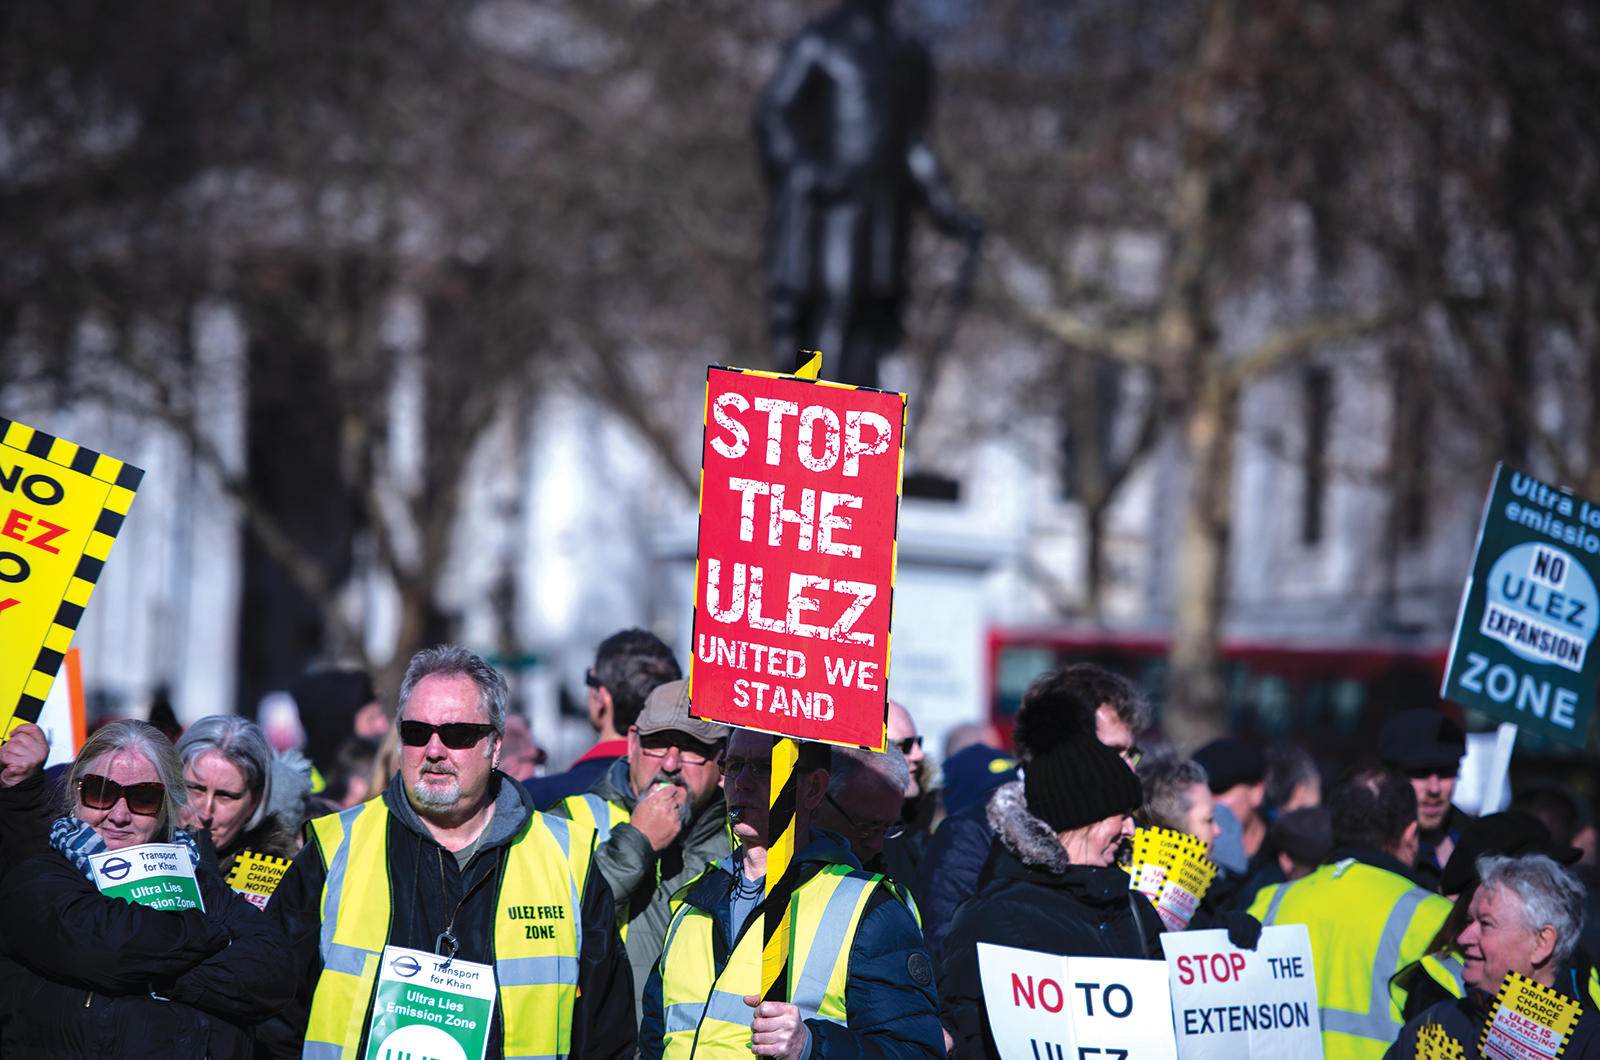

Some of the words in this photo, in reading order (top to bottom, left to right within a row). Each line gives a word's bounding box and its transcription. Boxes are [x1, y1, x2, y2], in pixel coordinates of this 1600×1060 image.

[710, 392, 892, 477] STOP
[1510, 471, 1574, 518] Ultra
[1579, 501, 1600, 529] lo
[0, 508, 70, 555] EZ
[729, 477, 863, 559] THE
[1504, 501, 1600, 558] emissio
[1533, 550, 1566, 584] NO
[706, 558, 877, 647] ULEZ
[1502, 573, 1588, 628] ULEZ
[1487, 609, 1583, 665] EXPANSION
[699, 634, 806, 679] UNITED
[824, 656, 879, 691] WE
[733, 679, 835, 722] STAND
[1458, 651, 1580, 730] ZONE
[138, 852, 178, 861] Transport
[143, 863, 157, 872] for
[157, 862, 178, 871] Khan
[250, 863, 285, 877] DRIVIN
[130, 885, 162, 899] Ultra
[162, 882, 183, 893] Lies
[175, 896, 197, 908] Zone
[244, 882, 275, 894] NOTIC
[244, 893, 266, 904] LEZ
[508, 906, 536, 920] ULEZ
[537, 905, 565, 919] FREE
[525, 925, 556, 939] ZONE
[430, 974, 444, 985] for
[446, 977, 472, 990] Khan
[1177, 953, 1246, 985] STOP
[1267, 957, 1305, 979] THE
[406, 990, 436, 1006] Ultra
[438, 997, 464, 1012] Lies
[1011, 973, 1064, 1013] NO
[1075, 983, 1133, 1018] TO
[1517, 995, 1560, 1020] CHARGE
[1520, 986, 1564, 1012] DRIVING
[386, 1001, 443, 1023] Emission
[444, 1013, 477, 1030] Zone
[1184, 1002, 1309, 1035] EXTENSION
[1508, 1012, 1538, 1032] ULEZ
[1540, 1028, 1552, 1039] IS
[1515, 1004, 1554, 1027] NOTICE
[1497, 1015, 1557, 1049] EXPANDING
